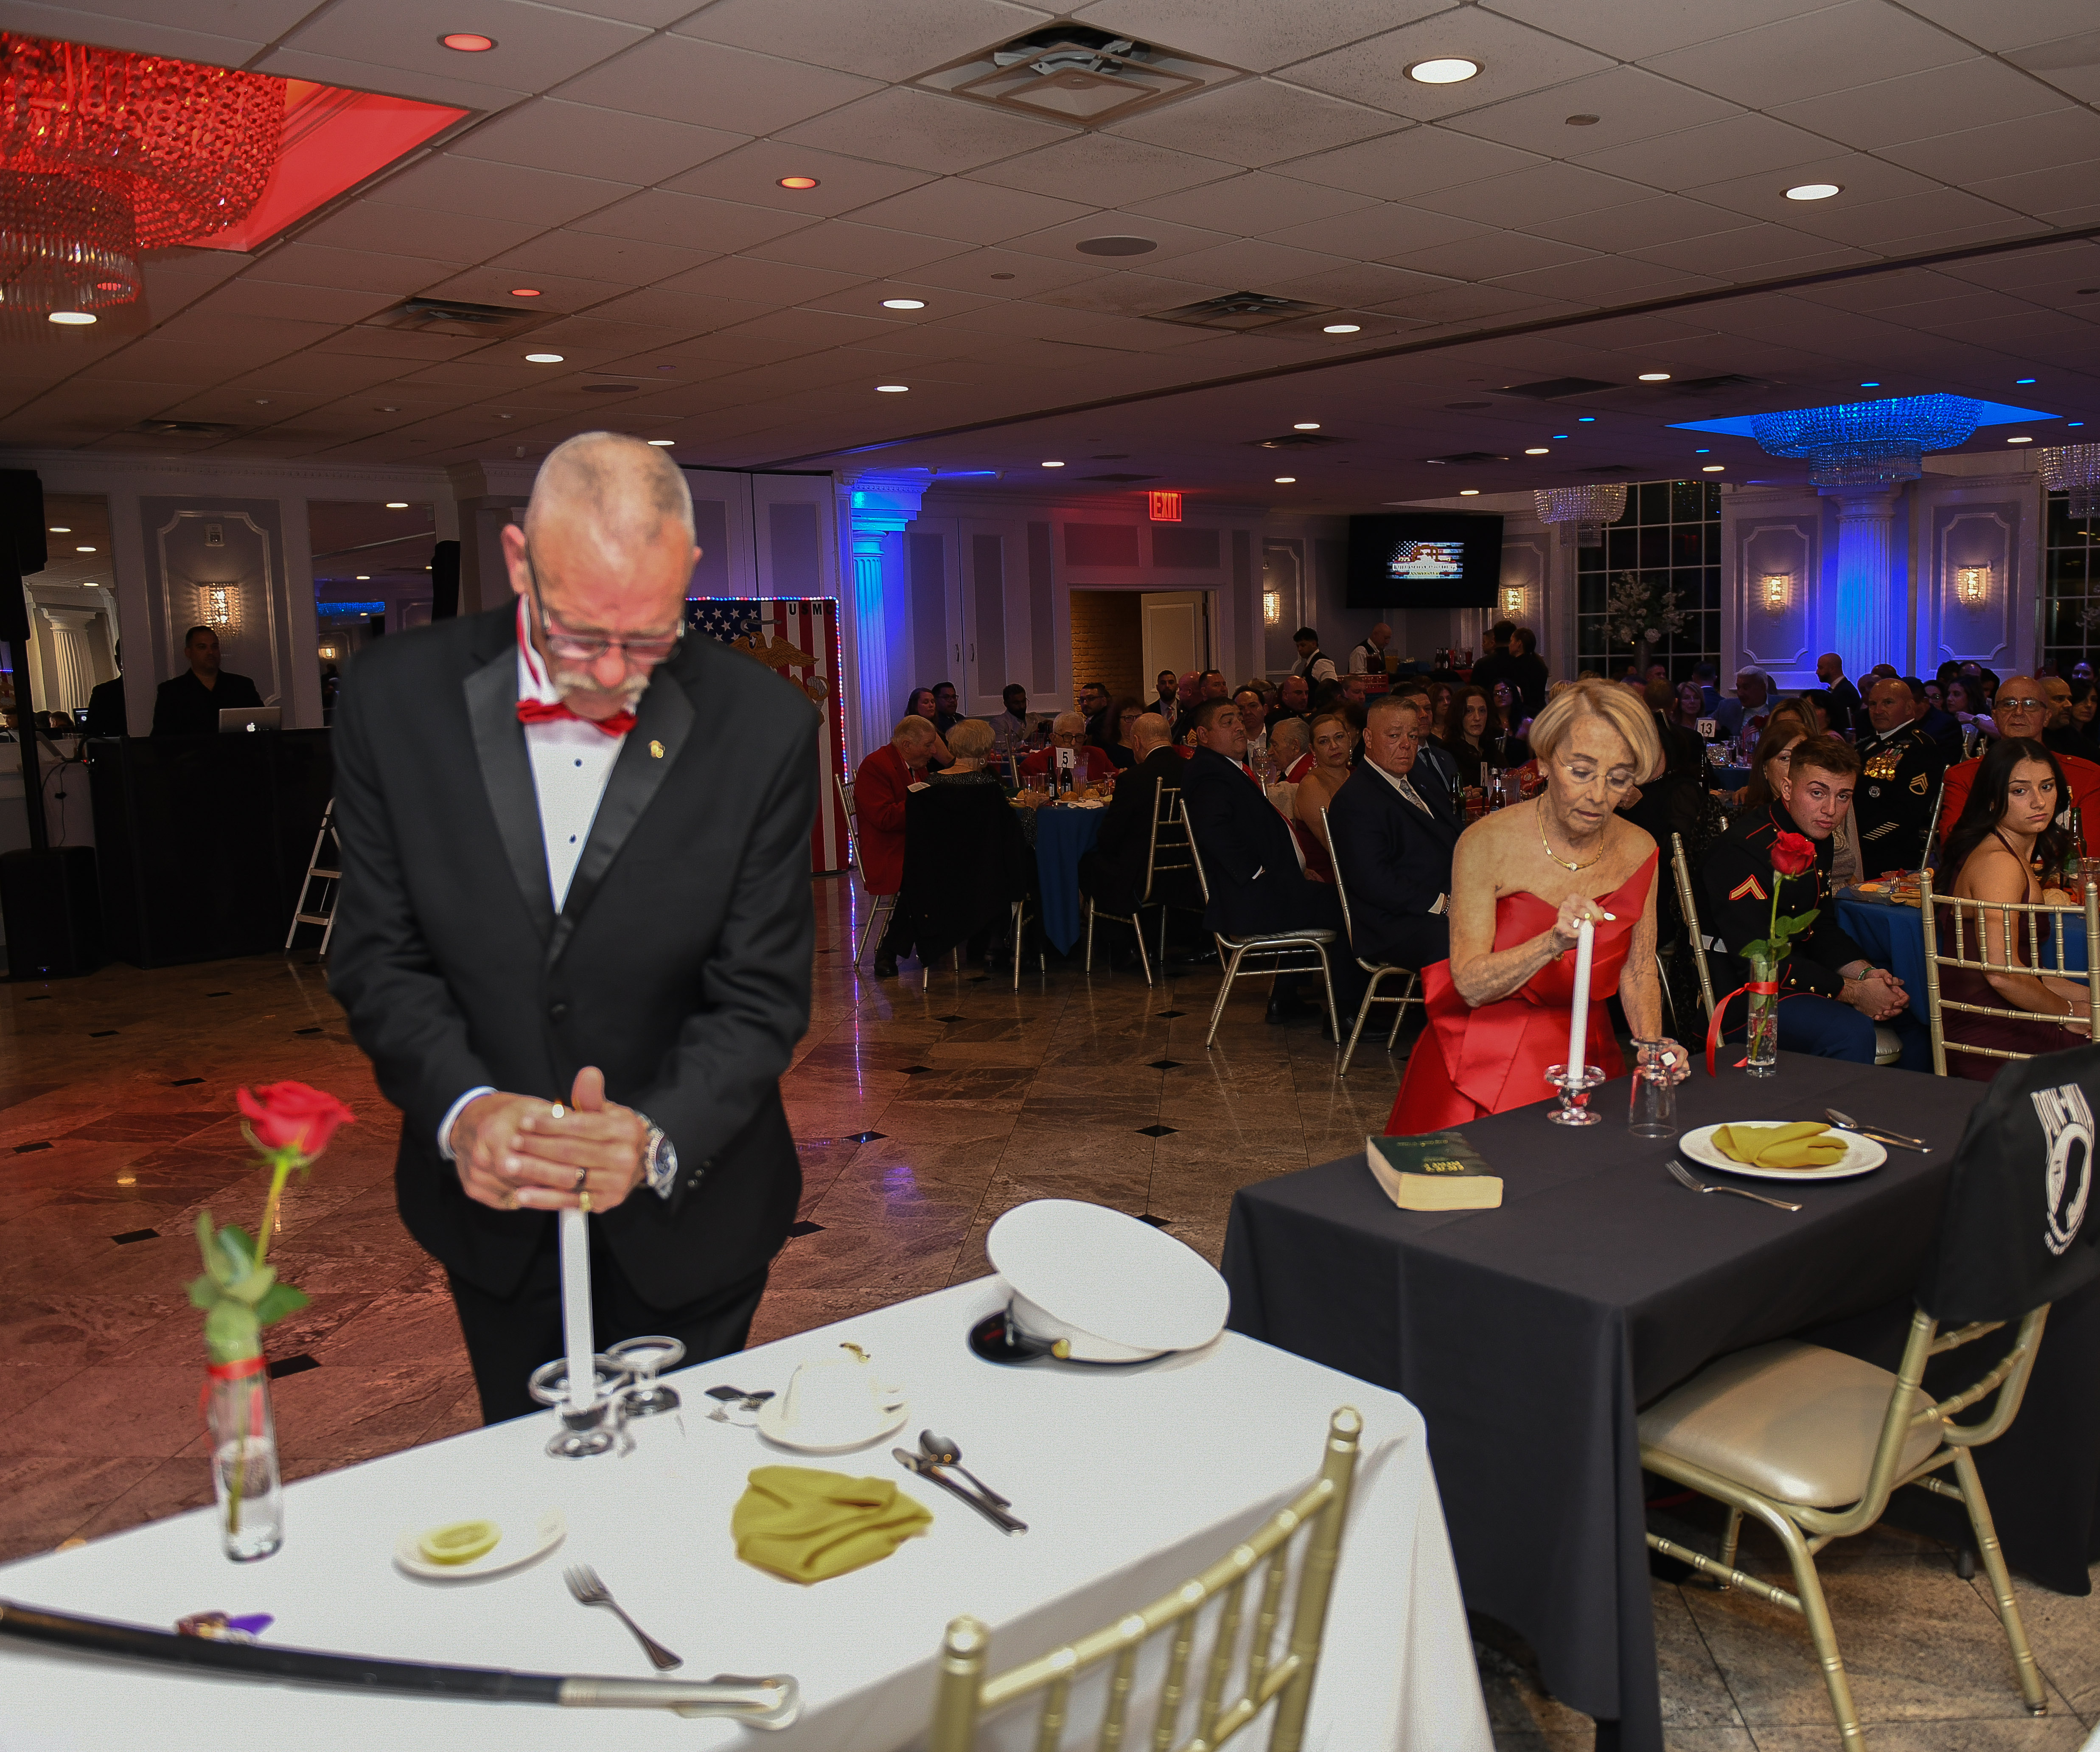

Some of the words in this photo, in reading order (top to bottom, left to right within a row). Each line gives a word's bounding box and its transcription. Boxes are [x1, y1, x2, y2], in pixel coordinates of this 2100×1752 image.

[1154, 492, 1178, 519] EXIT
[789, 603, 833, 615] USMC
[1700, 722, 1712, 734] 13
[1063, 751, 1068, 764] 5
